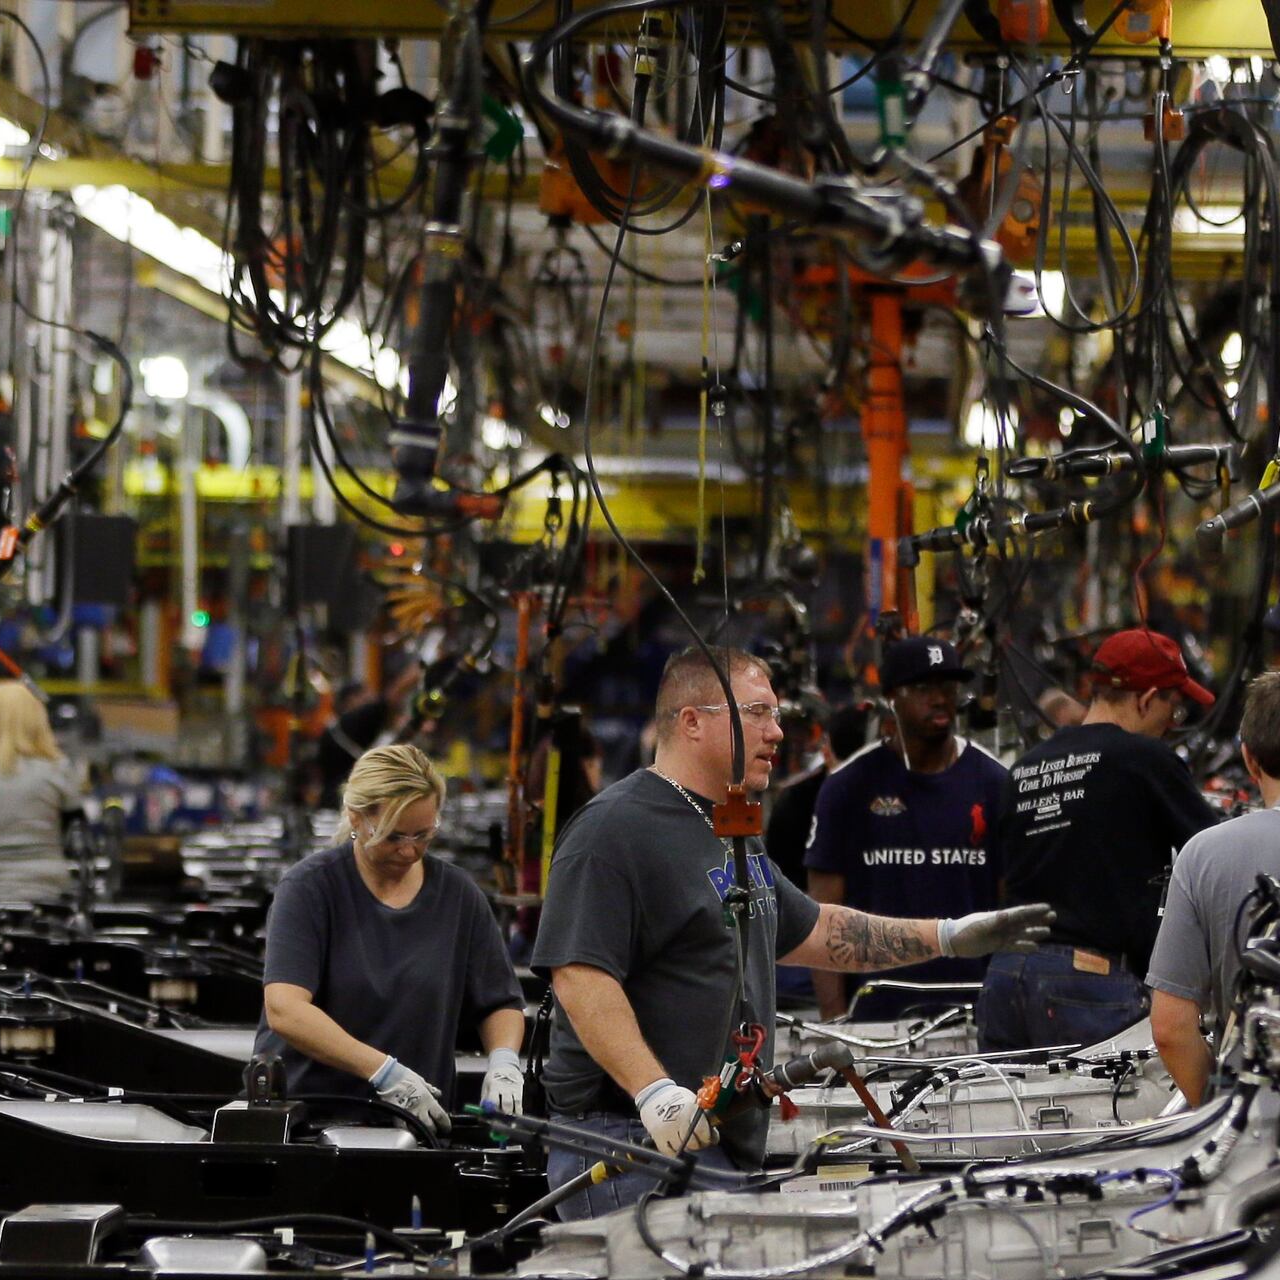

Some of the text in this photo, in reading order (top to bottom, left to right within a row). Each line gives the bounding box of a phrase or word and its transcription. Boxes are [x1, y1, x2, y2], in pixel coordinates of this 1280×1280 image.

[1063, 789, 1085, 801] BAR
[863, 848, 987, 866] UNITED STATES
